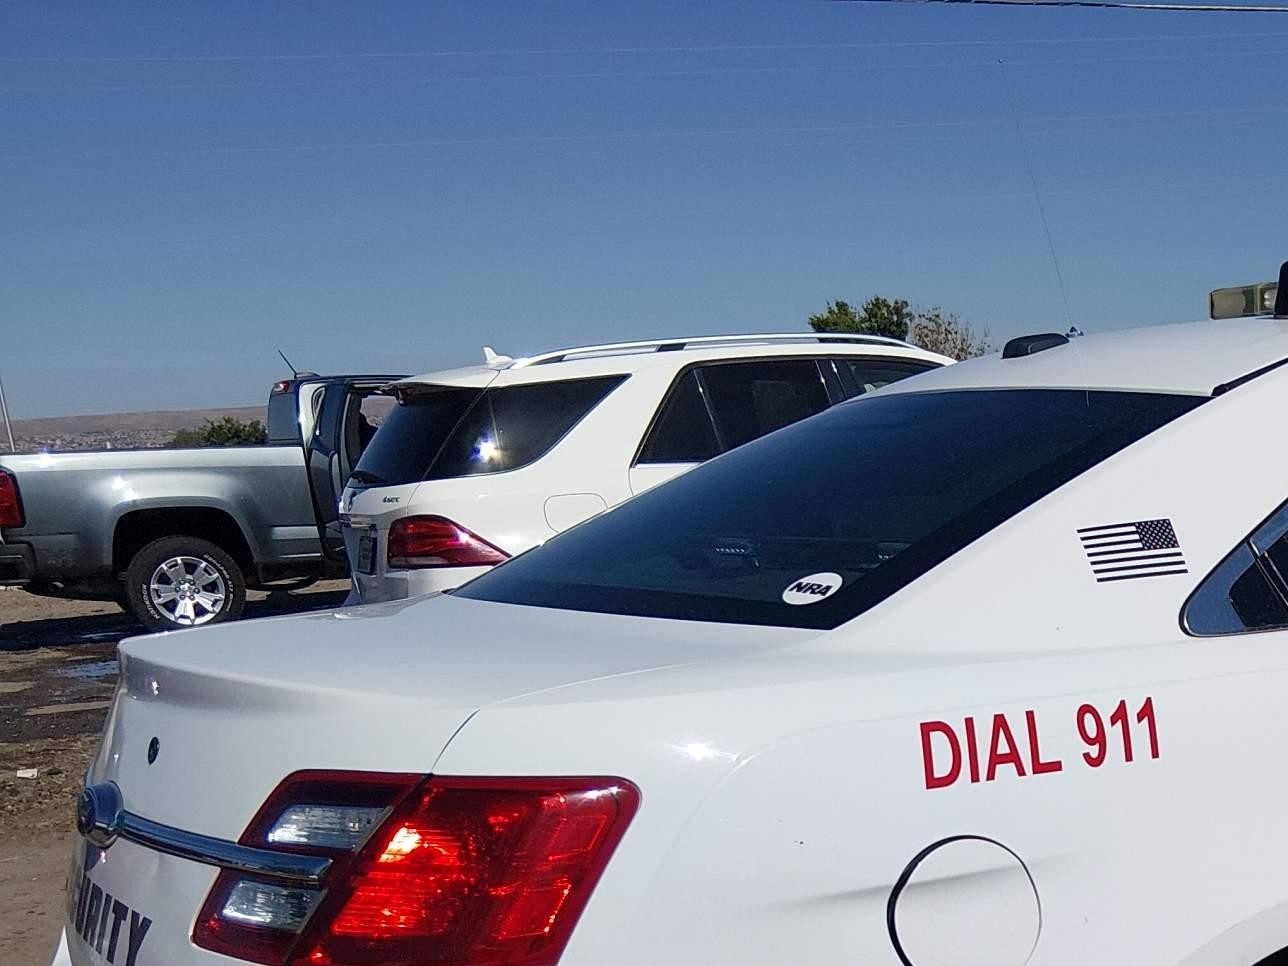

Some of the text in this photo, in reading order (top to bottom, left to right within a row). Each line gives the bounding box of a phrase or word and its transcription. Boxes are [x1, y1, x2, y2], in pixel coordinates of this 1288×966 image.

[788, 581, 834, 597] NRA
[919, 696, 1160, 790] DIAL 911
